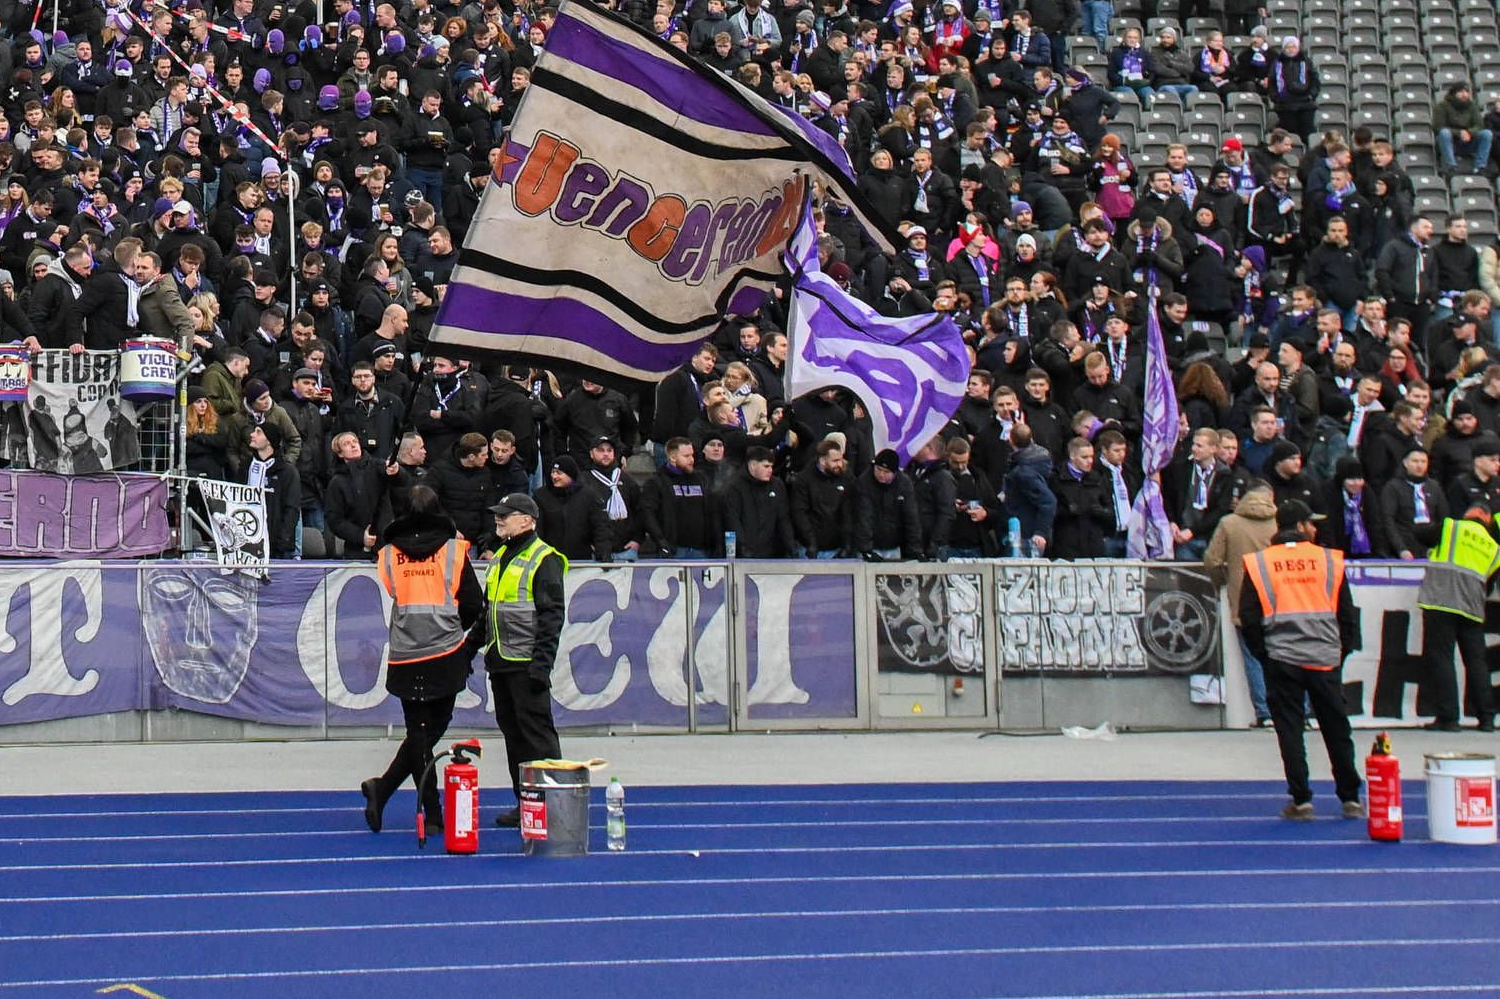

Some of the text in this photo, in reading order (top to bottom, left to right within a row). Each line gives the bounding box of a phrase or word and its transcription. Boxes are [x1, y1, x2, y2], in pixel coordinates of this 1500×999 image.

[137, 353, 176, 366] VIOLE
[202, 481, 262, 502] SEKTION
[1274, 560, 1317, 572] BEST
[948, 558, 1146, 616] SZIONE
[297, 563, 810, 713] CEW
[949, 613, 1148, 672] CPANNA
